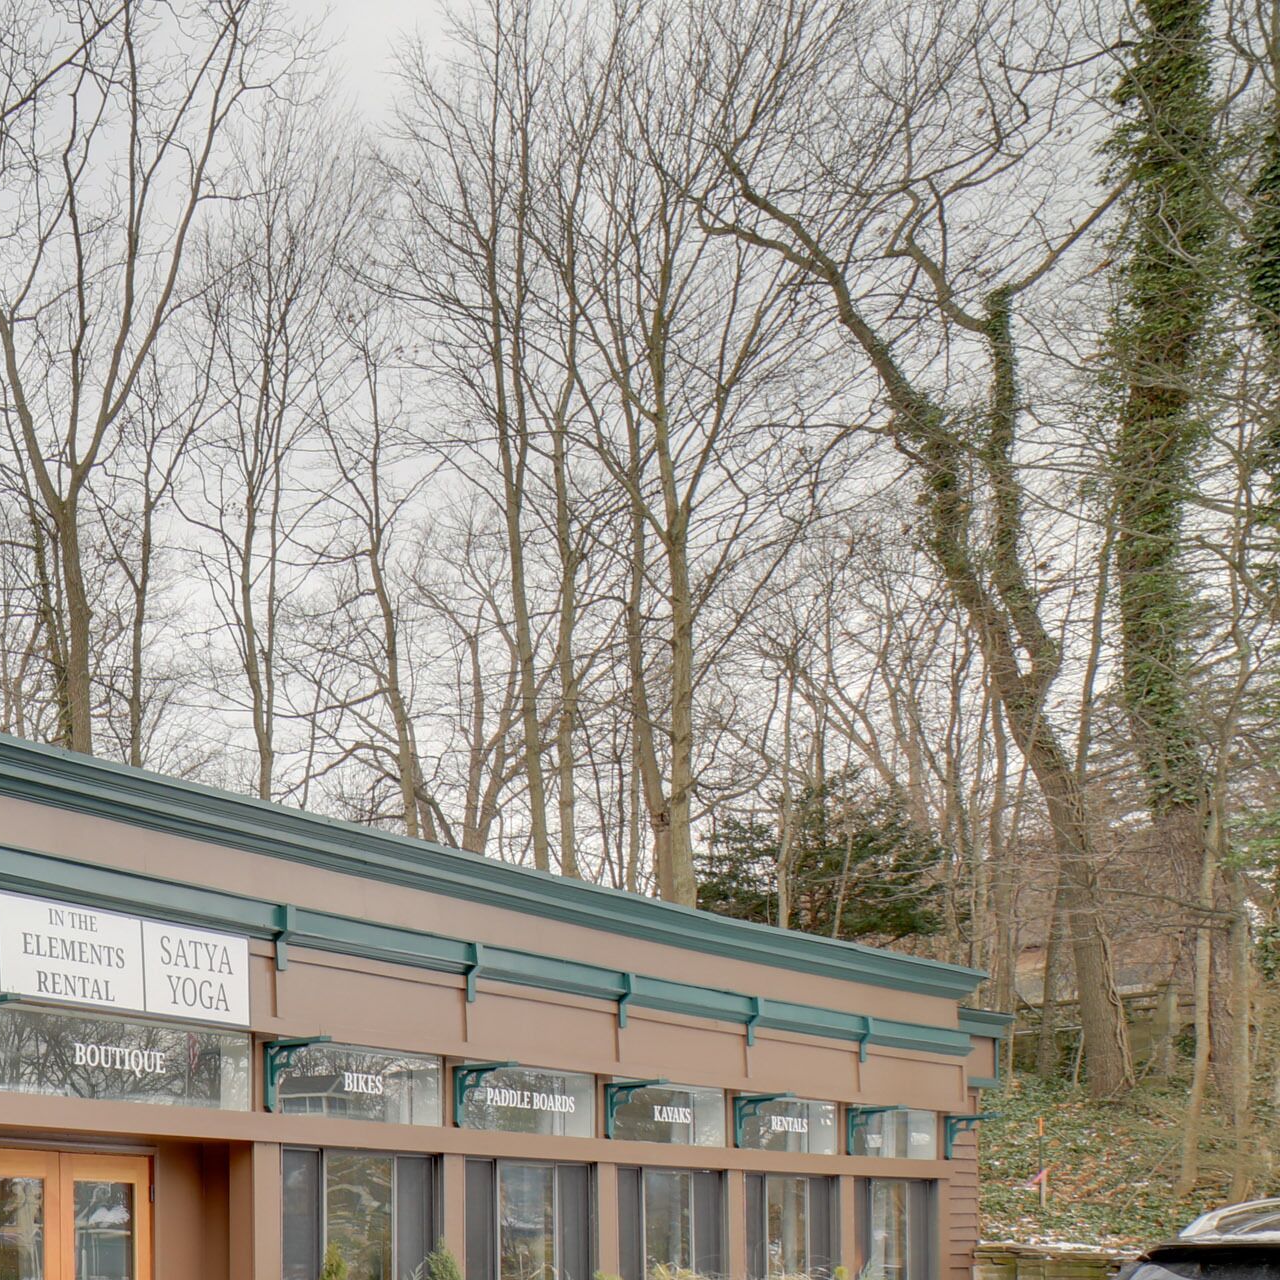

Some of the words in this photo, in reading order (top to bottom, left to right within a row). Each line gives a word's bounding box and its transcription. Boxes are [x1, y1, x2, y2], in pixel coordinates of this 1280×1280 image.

[48, 907, 64, 927] IN
[68, 911, 97, 932] THE
[22, 932, 125, 969] ELEMENTS
[160, 935, 233, 975] SATYA
[37, 970, 115, 1002] RENTAL
[166, 975, 230, 1011] YOGA
[74, 1044, 166, 1077] BOUTIQUE
[344, 1072, 383, 1095] BIKES
[487, 1088, 531, 1109] PADDLE
[533, 1093, 575, 1113] BOARDS
[654, 1105, 691, 1124] KAYAKS
[771, 1116, 808, 1133] RENTALS
